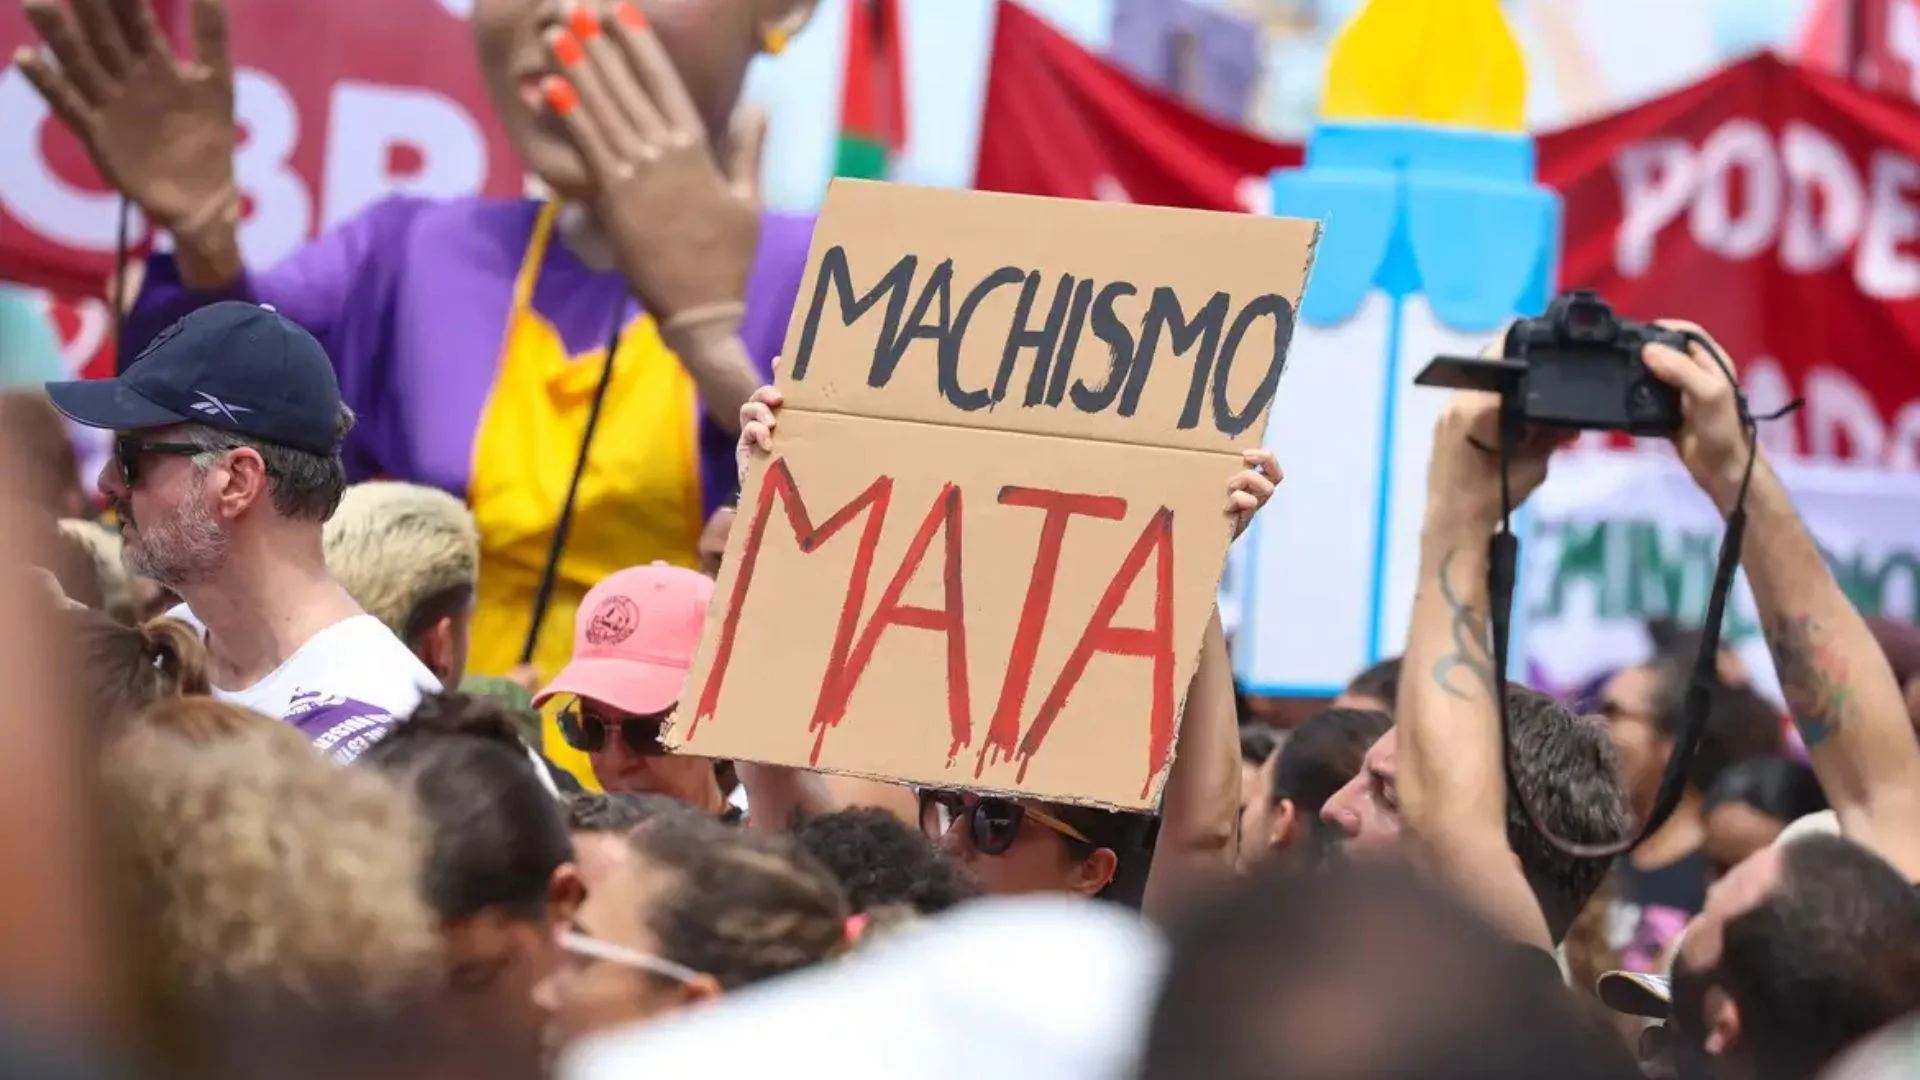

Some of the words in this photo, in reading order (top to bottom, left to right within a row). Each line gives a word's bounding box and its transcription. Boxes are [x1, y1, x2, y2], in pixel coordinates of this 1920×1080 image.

[1610, 116, 1920, 300] PODE
[791, 245, 1297, 440] MACHISMO
[686, 456, 1176, 800] MATA
